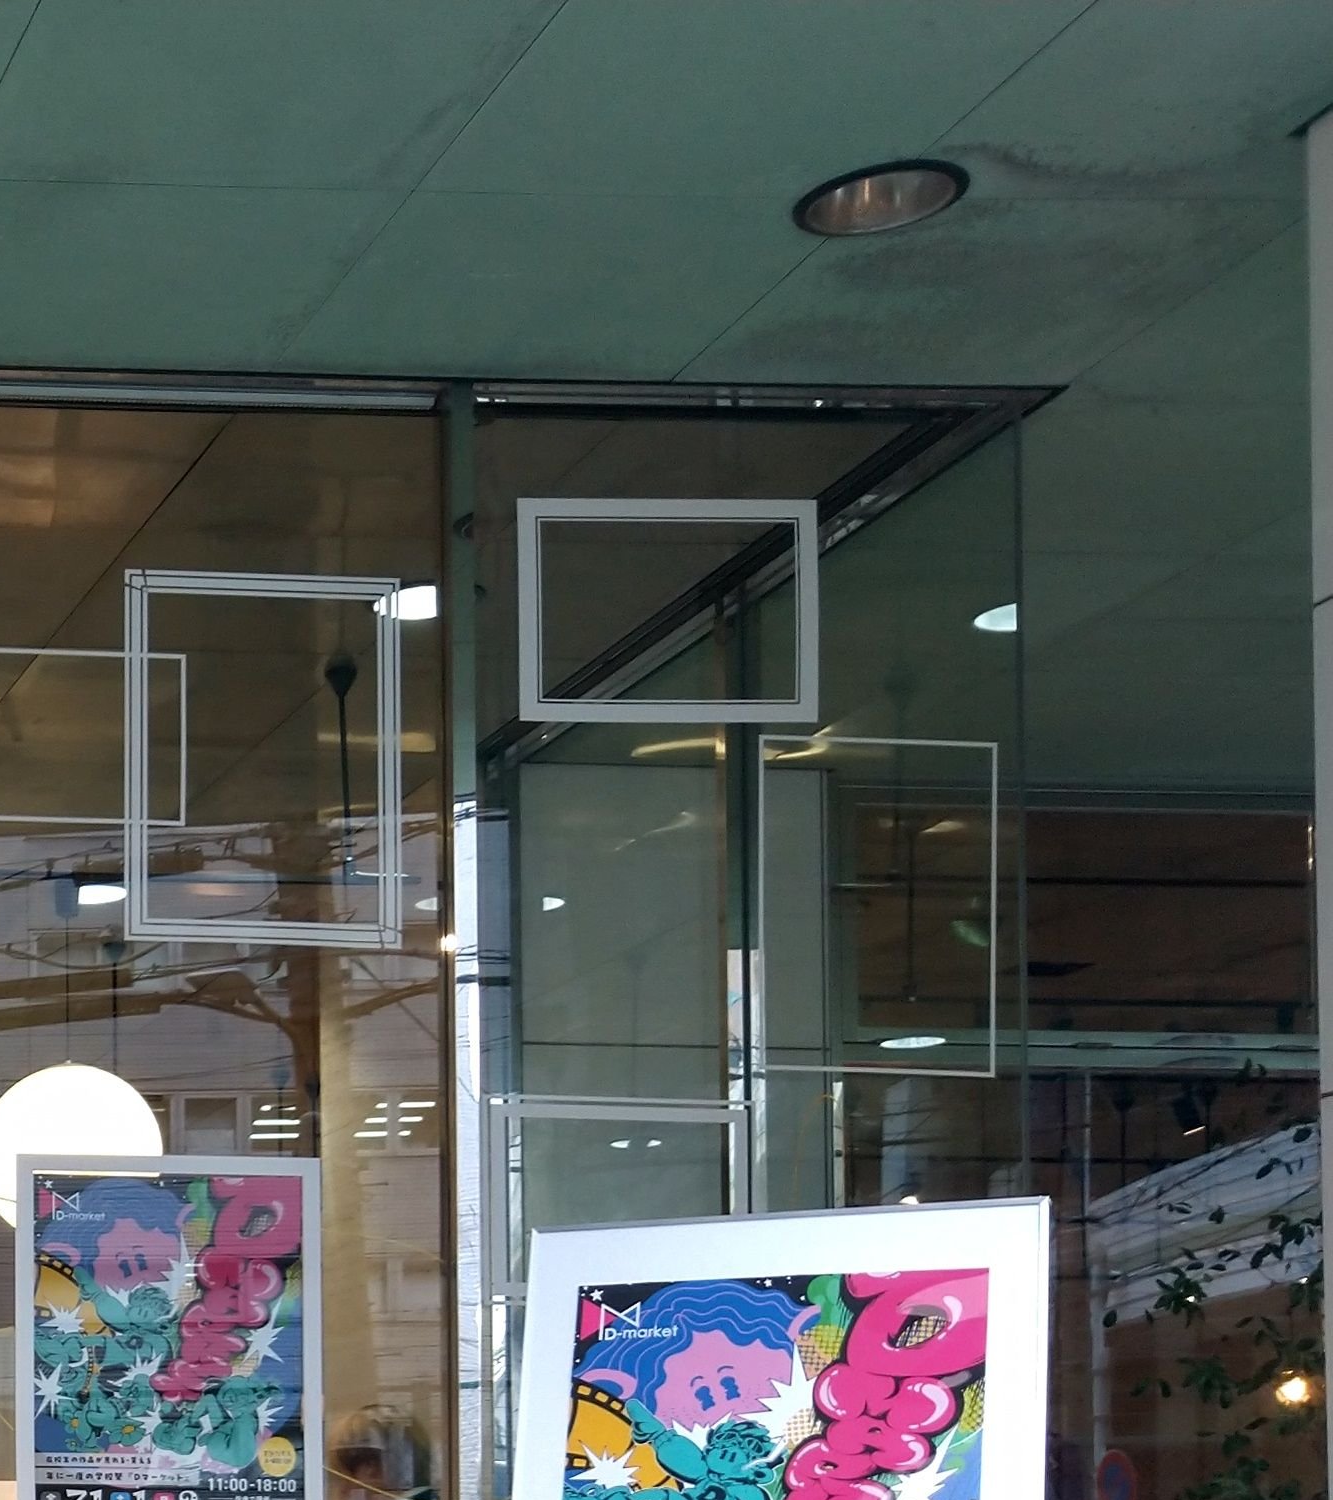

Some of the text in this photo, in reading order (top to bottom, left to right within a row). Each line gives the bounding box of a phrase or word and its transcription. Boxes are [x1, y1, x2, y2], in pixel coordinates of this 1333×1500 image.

[56, 1210, 105, 1221] D-market
[605, 1325, 679, 1341] D-market
[207, 1478, 297, 1492] 11:00-18:00
